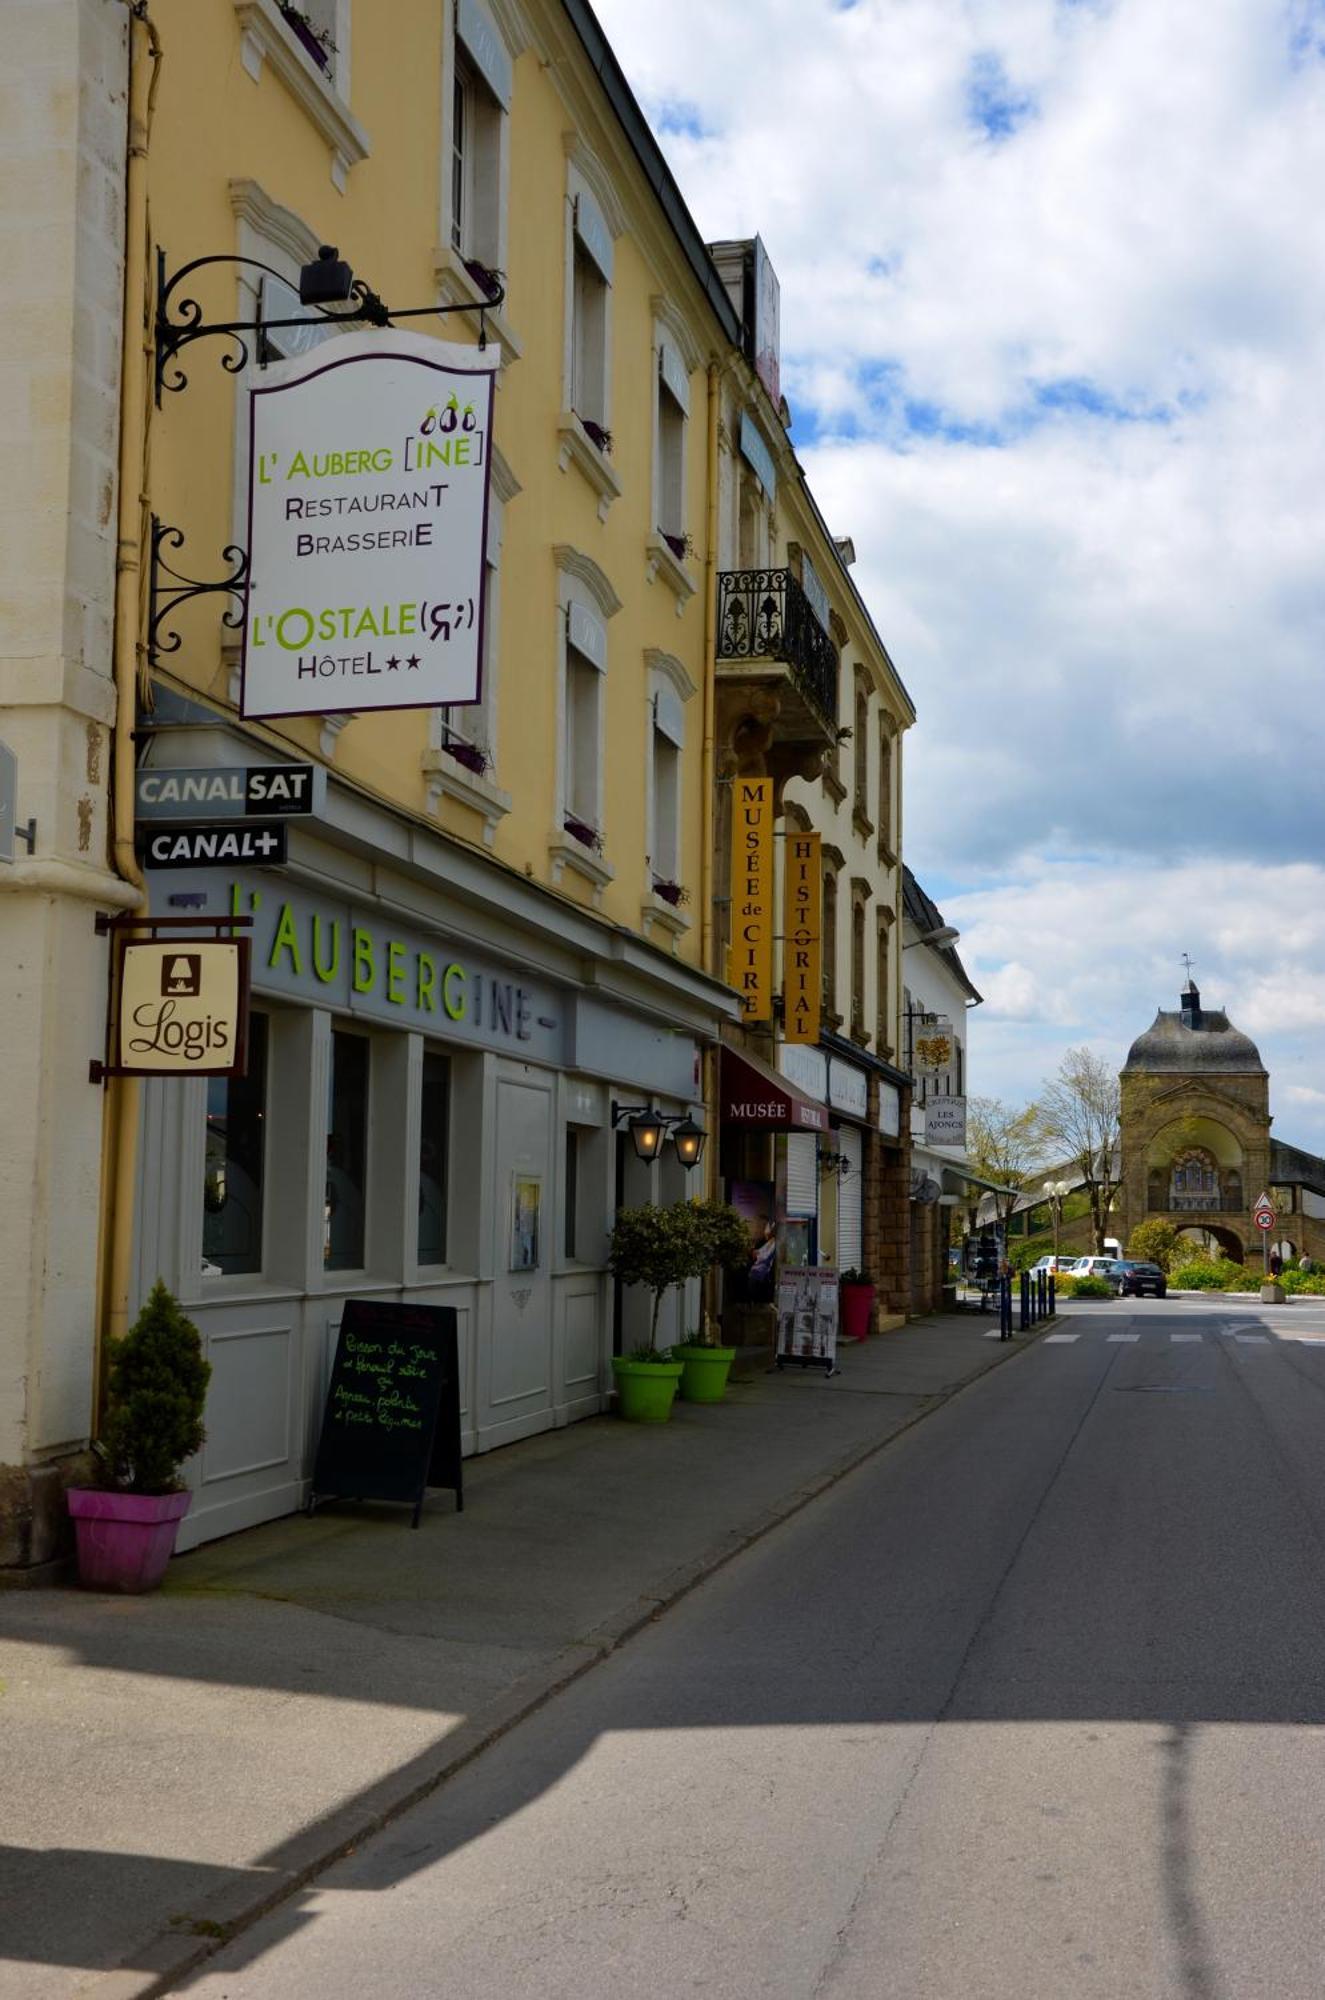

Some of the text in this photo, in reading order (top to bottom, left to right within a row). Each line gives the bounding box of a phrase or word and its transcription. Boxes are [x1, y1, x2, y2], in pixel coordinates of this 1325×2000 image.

[287, 449, 393, 480] AUBERG
[286, 484, 448, 520] RESTAURANT
[297, 524, 432, 556] BRASSERIE
[298, 652, 381, 679] HÔTEL
[151, 831, 278, 860] CANAL+
[742, 785, 765, 1013] MUSÉE de CIRE
[795, 842, 811, 1034] HISTORIAL
[129, 1000, 228, 1060] Logis
[730, 1102, 786, 1118] MUSÉE
[928, 1121, 963, 1129] AJONCS
[937, 1111, 954, 1119] LES
[387, 1339, 406, 1355] du
